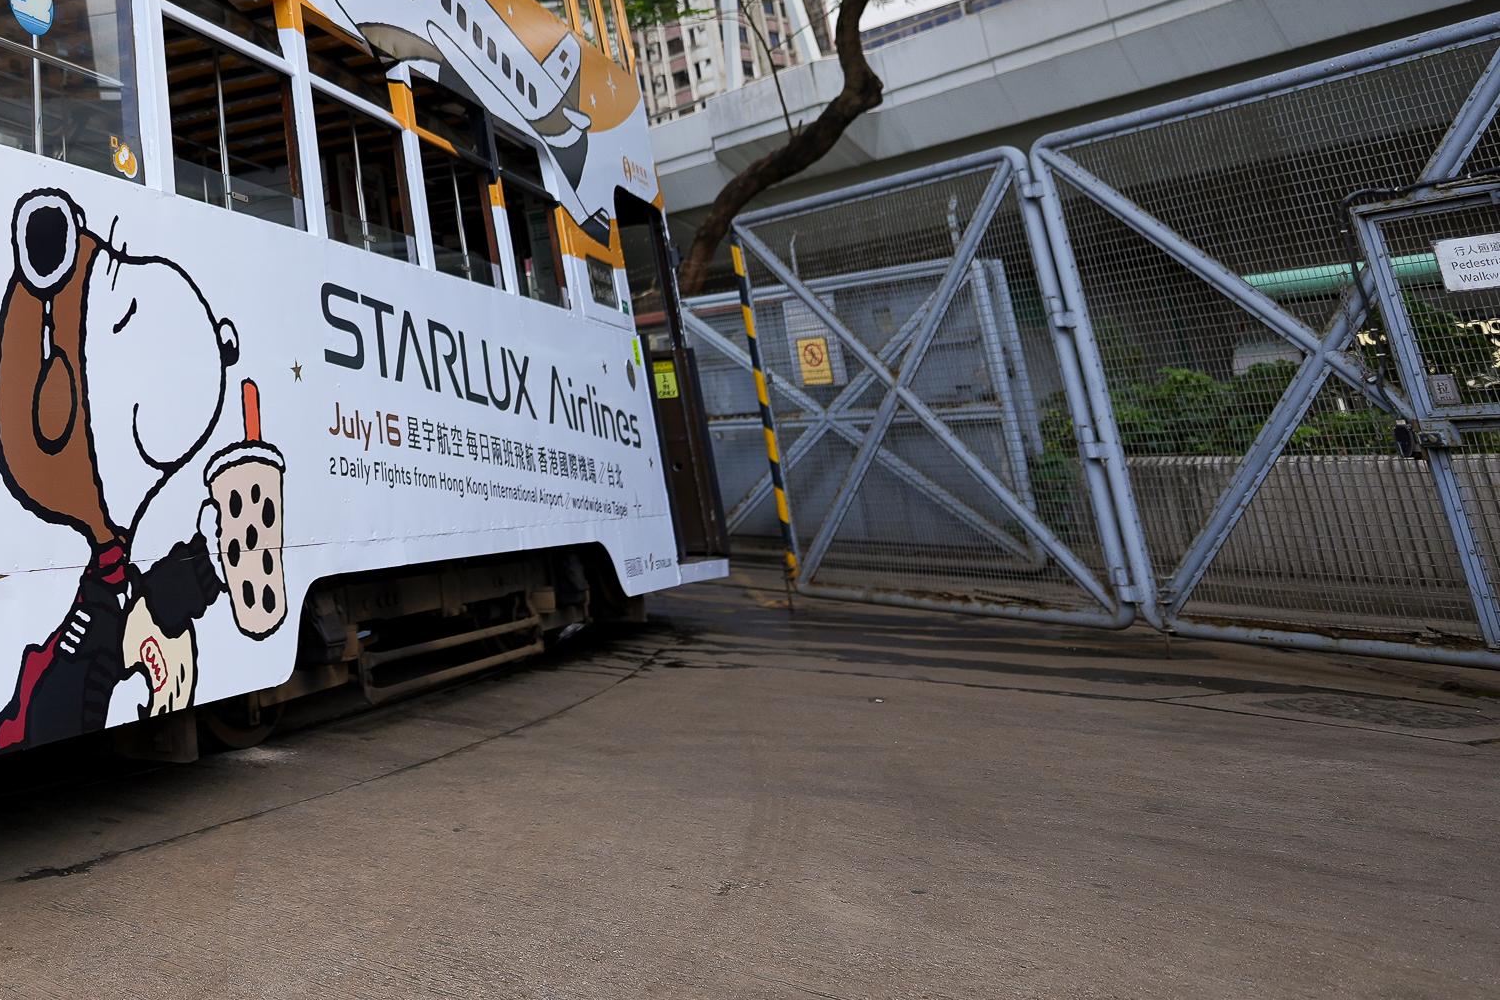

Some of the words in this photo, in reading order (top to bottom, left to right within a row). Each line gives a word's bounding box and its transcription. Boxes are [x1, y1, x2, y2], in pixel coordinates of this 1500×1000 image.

[1451, 255, 1500, 271] Pedestri
[320, 282, 537, 420] STARLUX
[549, 365, 642, 449] Airlines
[329, 402, 372, 451] July
[376, 410, 401, 447] 16
[329, 457, 337, 475] 2
[339, 456, 371, 486] Daily
[374, 461, 412, 489] Flights
[414, 466, 438, 489] from
[439, 471, 465, 498] Hong
[466, 475, 489, 501] Kong
[489, 480, 537, 503] International
[539, 488, 563, 510] Airport
